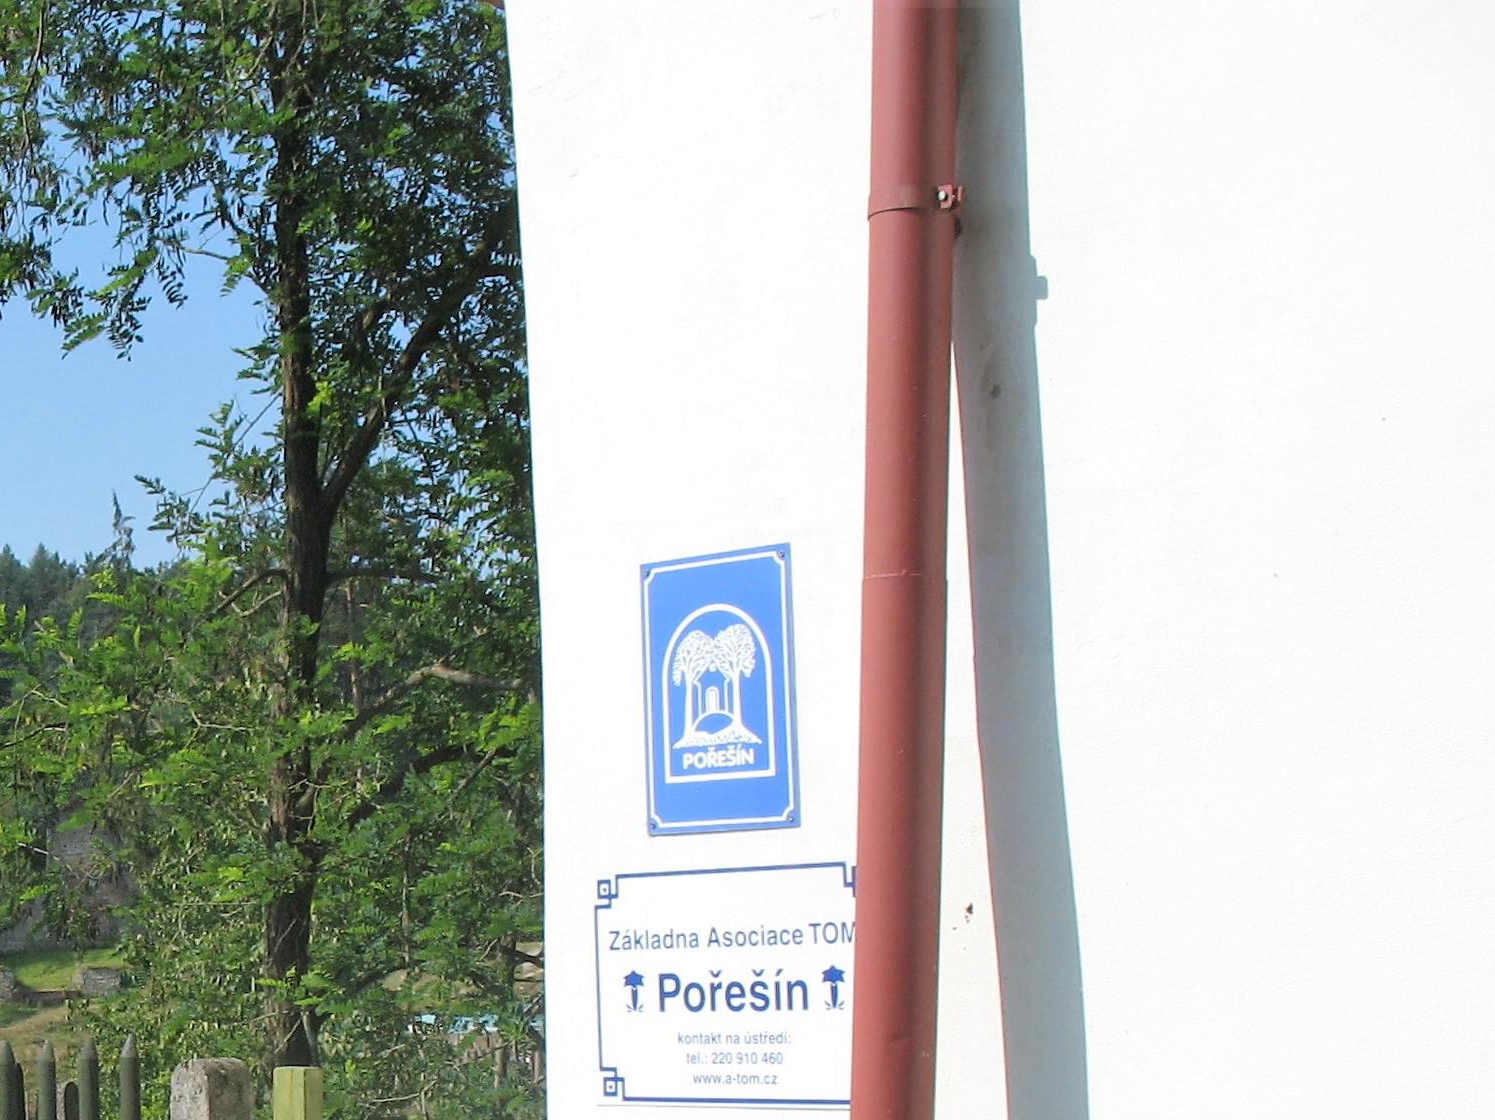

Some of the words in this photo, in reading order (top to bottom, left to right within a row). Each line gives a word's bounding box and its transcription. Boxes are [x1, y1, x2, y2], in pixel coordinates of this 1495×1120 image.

[682, 744, 755, 770] POŘEŠÍN
[608, 928, 700, 951] Základna
[707, 924, 804, 947] Asociace
[808, 921, 857, 945] TOM
[658, 968, 809, 1013] Pořešín
[677, 1031, 722, 1045] kontakt
[725, 1034, 741, 1045] na
[686, 1052, 708, 1065] tel.:
[711, 1052, 733, 1065] 220
[737, 1052, 758, 1065] 910
[692, 1072, 779, 1086] www.a-tom.cz
